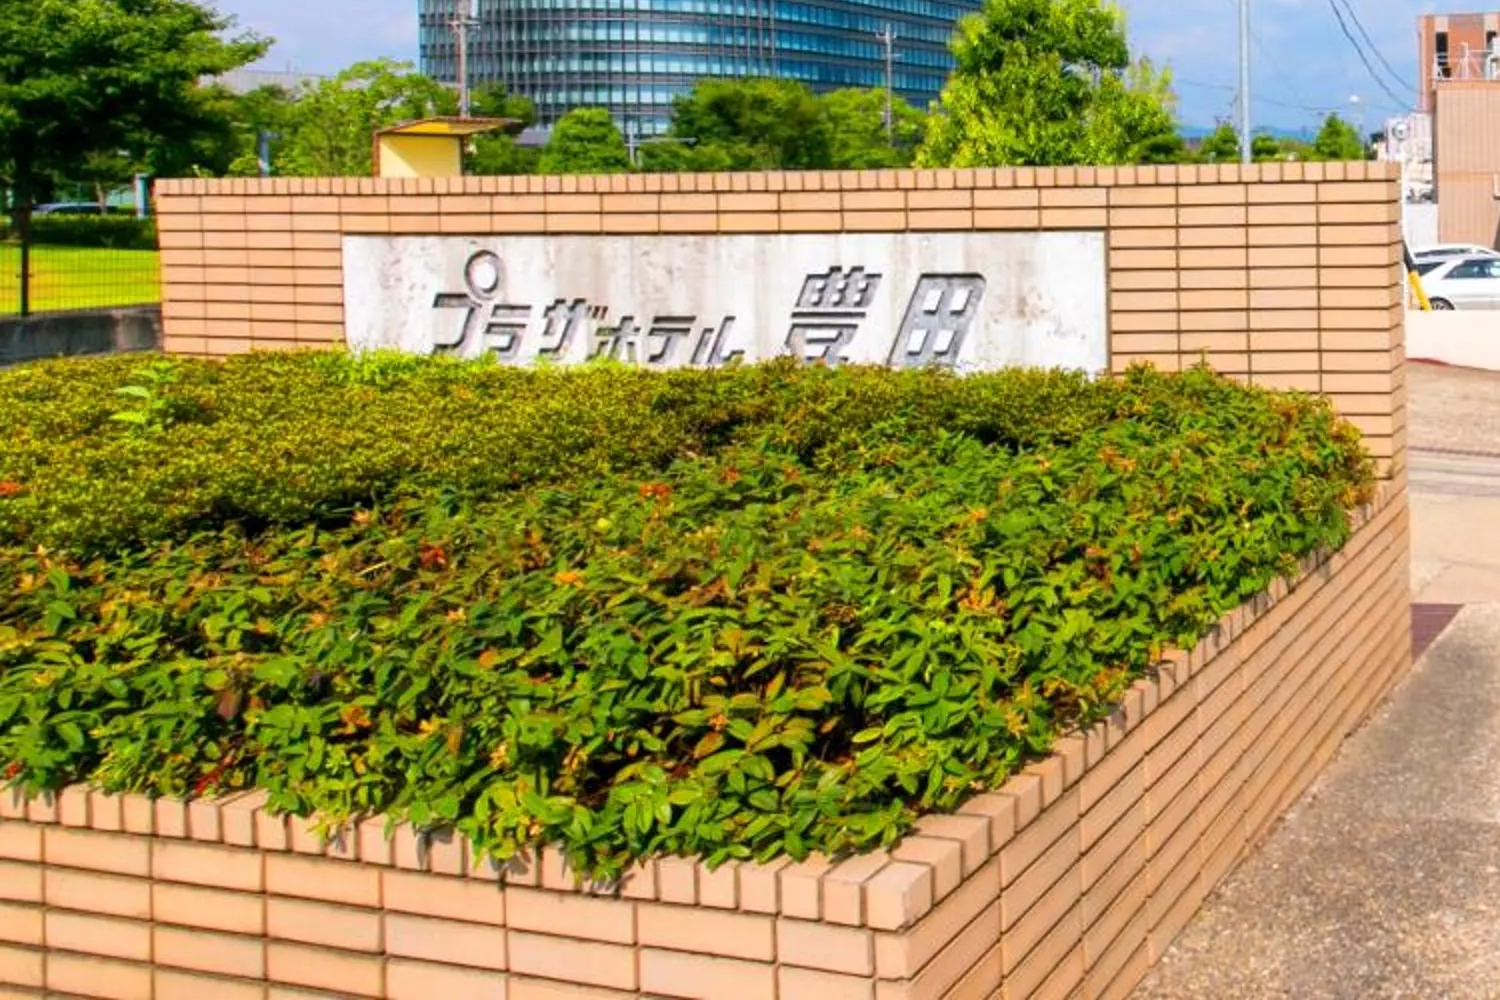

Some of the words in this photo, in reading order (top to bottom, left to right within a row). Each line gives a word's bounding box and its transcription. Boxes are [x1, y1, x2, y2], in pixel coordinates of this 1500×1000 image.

[432, 249, 745, 364] プラザホテル
[784, 265, 987, 367] 豊田
